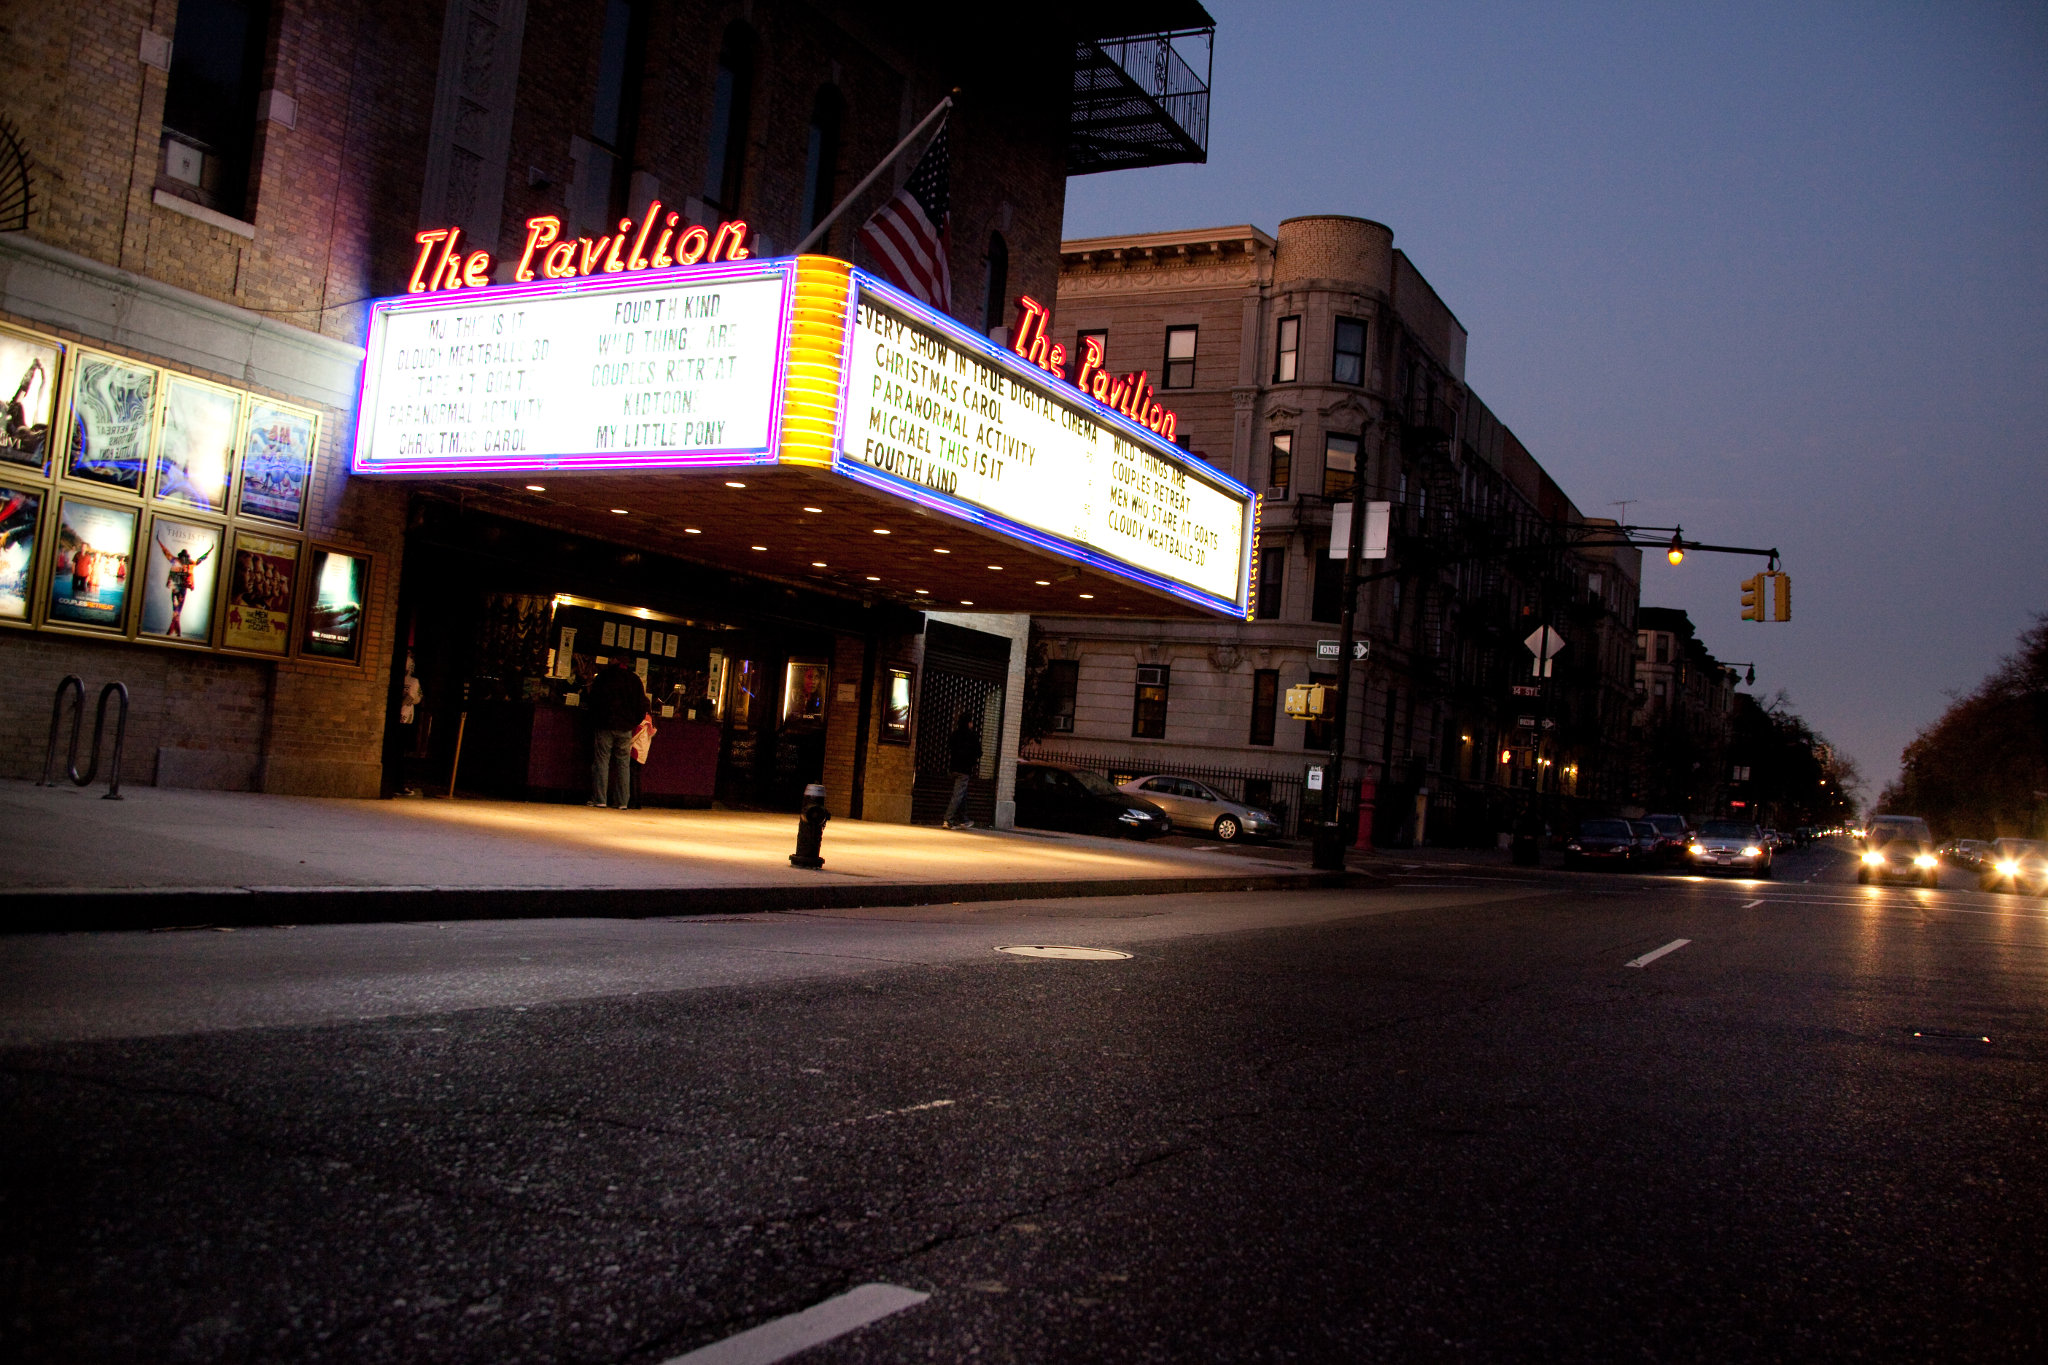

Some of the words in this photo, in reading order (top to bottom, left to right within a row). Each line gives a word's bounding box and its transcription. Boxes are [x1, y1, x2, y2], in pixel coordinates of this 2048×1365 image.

[408, 226, 490, 293] The
[515, 201, 751, 283] Pavilion
[614, 298, 677, 324] FOURTH
[684, 294, 720, 319] KIND
[398, 348, 443, 370] CLOUDY
[532, 339, 550, 361] 3D
[644, 327, 696, 352] THING
[707, 324, 737, 348] ARE
[486, 369, 534, 392] GOAT
[592, 361, 656, 387] COUPLES
[856, 304, 904, 344] EVERY
[910, 327, 948, 367] SHOW
[954, 352, 967, 376] IN
[973, 361, 1004, 396] TRUE
[1010, 380, 1056, 423] DIGITAL
[1061, 408, 1098, 444] CINEMA
[876, 343, 958, 402] CHRISTMAS
[963, 386, 1004, 425] CAROL
[1014, 295, 1067, 381] The
[1078, 336, 1178, 443] Pavilion
[485, 428, 526, 452] CAROL
[596, 425, 618, 448] MY
[625, 423, 678, 448] LITTLE
[684, 420, 726, 446] PONY
[869, 407, 931, 454] MICHAEL
[939, 436, 968, 468] THIS
[973, 451, 987, 476] IS
[990, 460, 1004, 482] IT
[872, 375, 968, 438] PARANORMAL
[976, 423, 1036, 466] ACTIVITY
[864, 438, 922, 482] FOURTH
[926, 463, 957, 494] KIND
[1112, 461, 1151, 495] COUPLES
[1154, 481, 1191, 514] RETREAT
[1113, 434, 1135, 462] WILD
[1139, 450, 1168, 480] THINGS
[1170, 470, 1186, 490] ARE
[167, 528, 187, 539] THIS
[1108, 510, 1145, 541] CLOUDY
[1147, 528, 1194, 562] MEATBALLS
[1195, 549, 1206, 567] 3D
[1110, 485, 1128, 509] MEN
[1131, 494, 1149, 519] WHO
[1152, 504, 1177, 532] STARE
[1180, 519, 1192, 537] AT
[1194, 525, 1218, 550] GOATS
[1322, 646, 1339, 654] ONE
